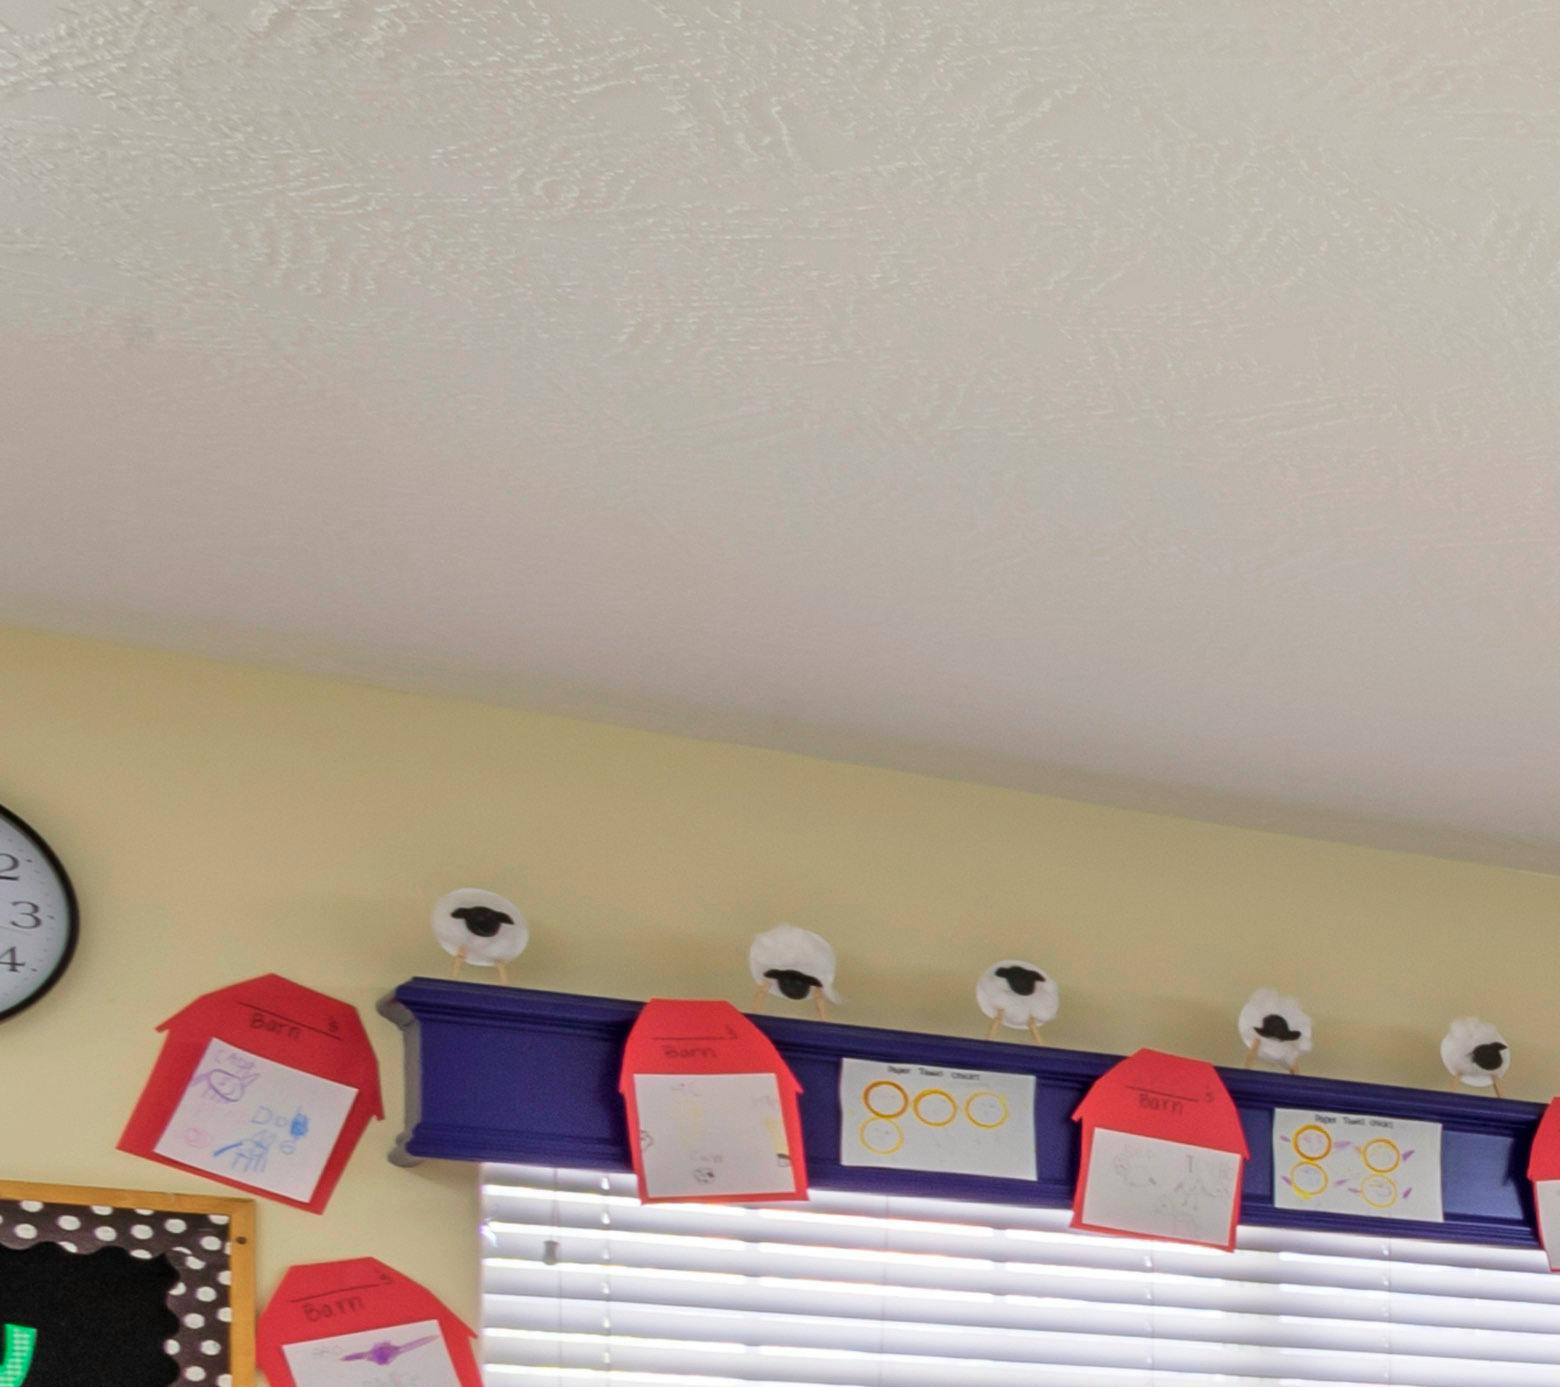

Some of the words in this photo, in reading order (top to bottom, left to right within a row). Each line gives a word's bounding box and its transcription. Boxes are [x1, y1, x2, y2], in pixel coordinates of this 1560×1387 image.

[11, 902, 42, 930] 3
[252, 1012, 300, 1039] Barn
[303, 1296, 362, 1322] Barn
